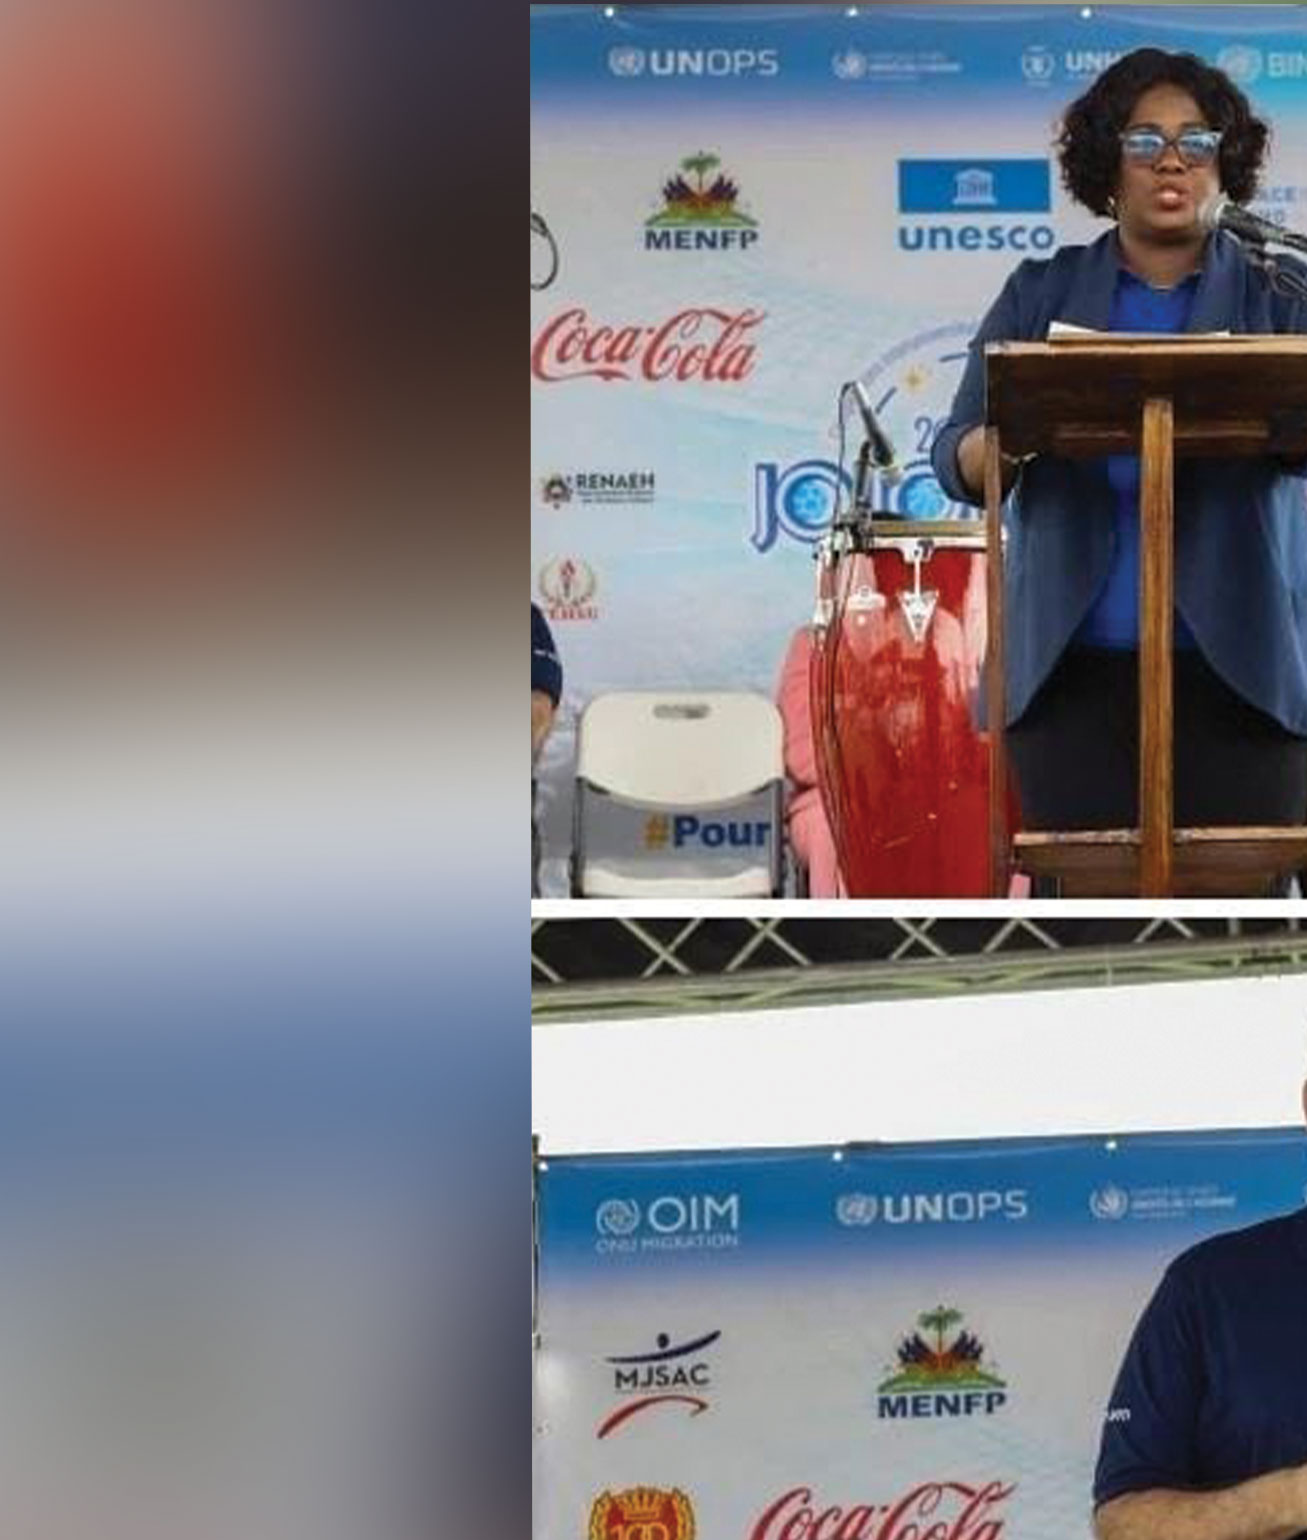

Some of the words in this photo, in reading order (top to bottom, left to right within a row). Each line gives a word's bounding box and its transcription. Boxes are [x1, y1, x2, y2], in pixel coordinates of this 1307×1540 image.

[651, 50, 779, 77] UNOPS
[645, 230, 759, 251] MENFP
[900, 224, 1056, 251] unesco
[577, 473, 655, 490] RENAEH
[645, 815, 771, 849] #Pour
[648, 1195, 739, 1231] OIM
[883, 1190, 1028, 1223] UNOPS
[615, 1364, 709, 1388] MJSAC
[877, 1391, 1007, 1418] MENFP
